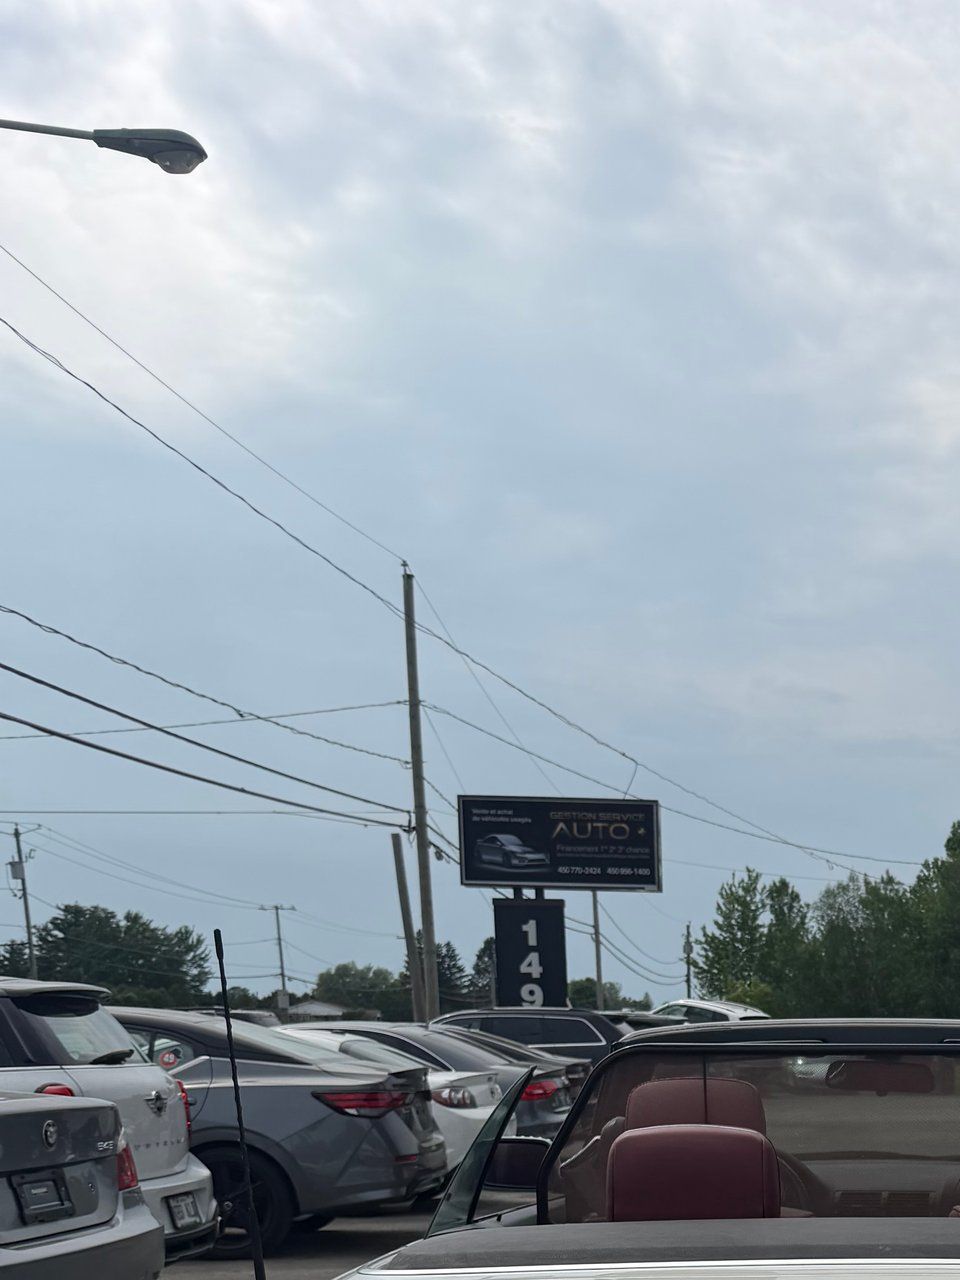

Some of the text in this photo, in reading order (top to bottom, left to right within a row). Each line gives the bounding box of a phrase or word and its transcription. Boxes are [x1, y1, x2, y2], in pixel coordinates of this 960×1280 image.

[549, 811, 645, 821] GESTION SERVICE
[551, 821, 630, 840] AUTO
